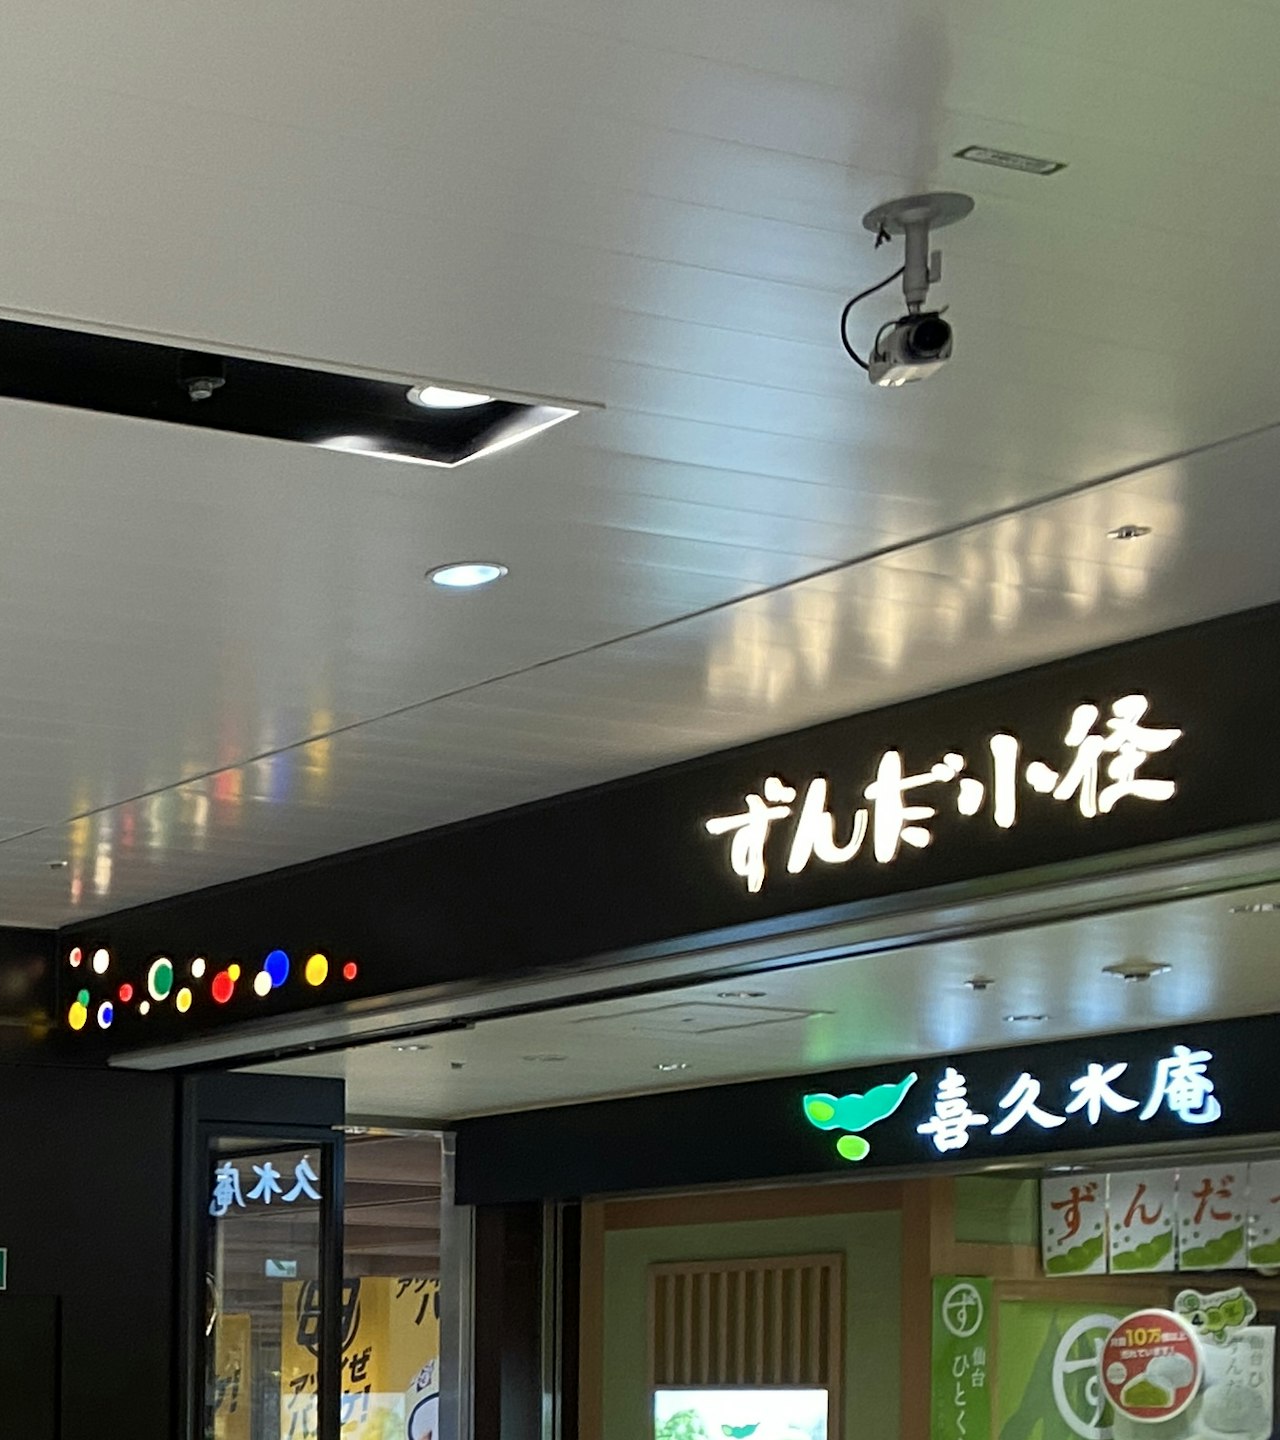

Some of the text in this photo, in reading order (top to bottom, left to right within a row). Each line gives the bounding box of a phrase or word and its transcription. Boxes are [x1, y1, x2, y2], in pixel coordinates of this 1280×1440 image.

[704, 693, 1184, 893] ずんだ小径
[916, 1044, 1223, 1154] 喜久水庵
[1050, 1174, 1280, 1245] ずんだ
